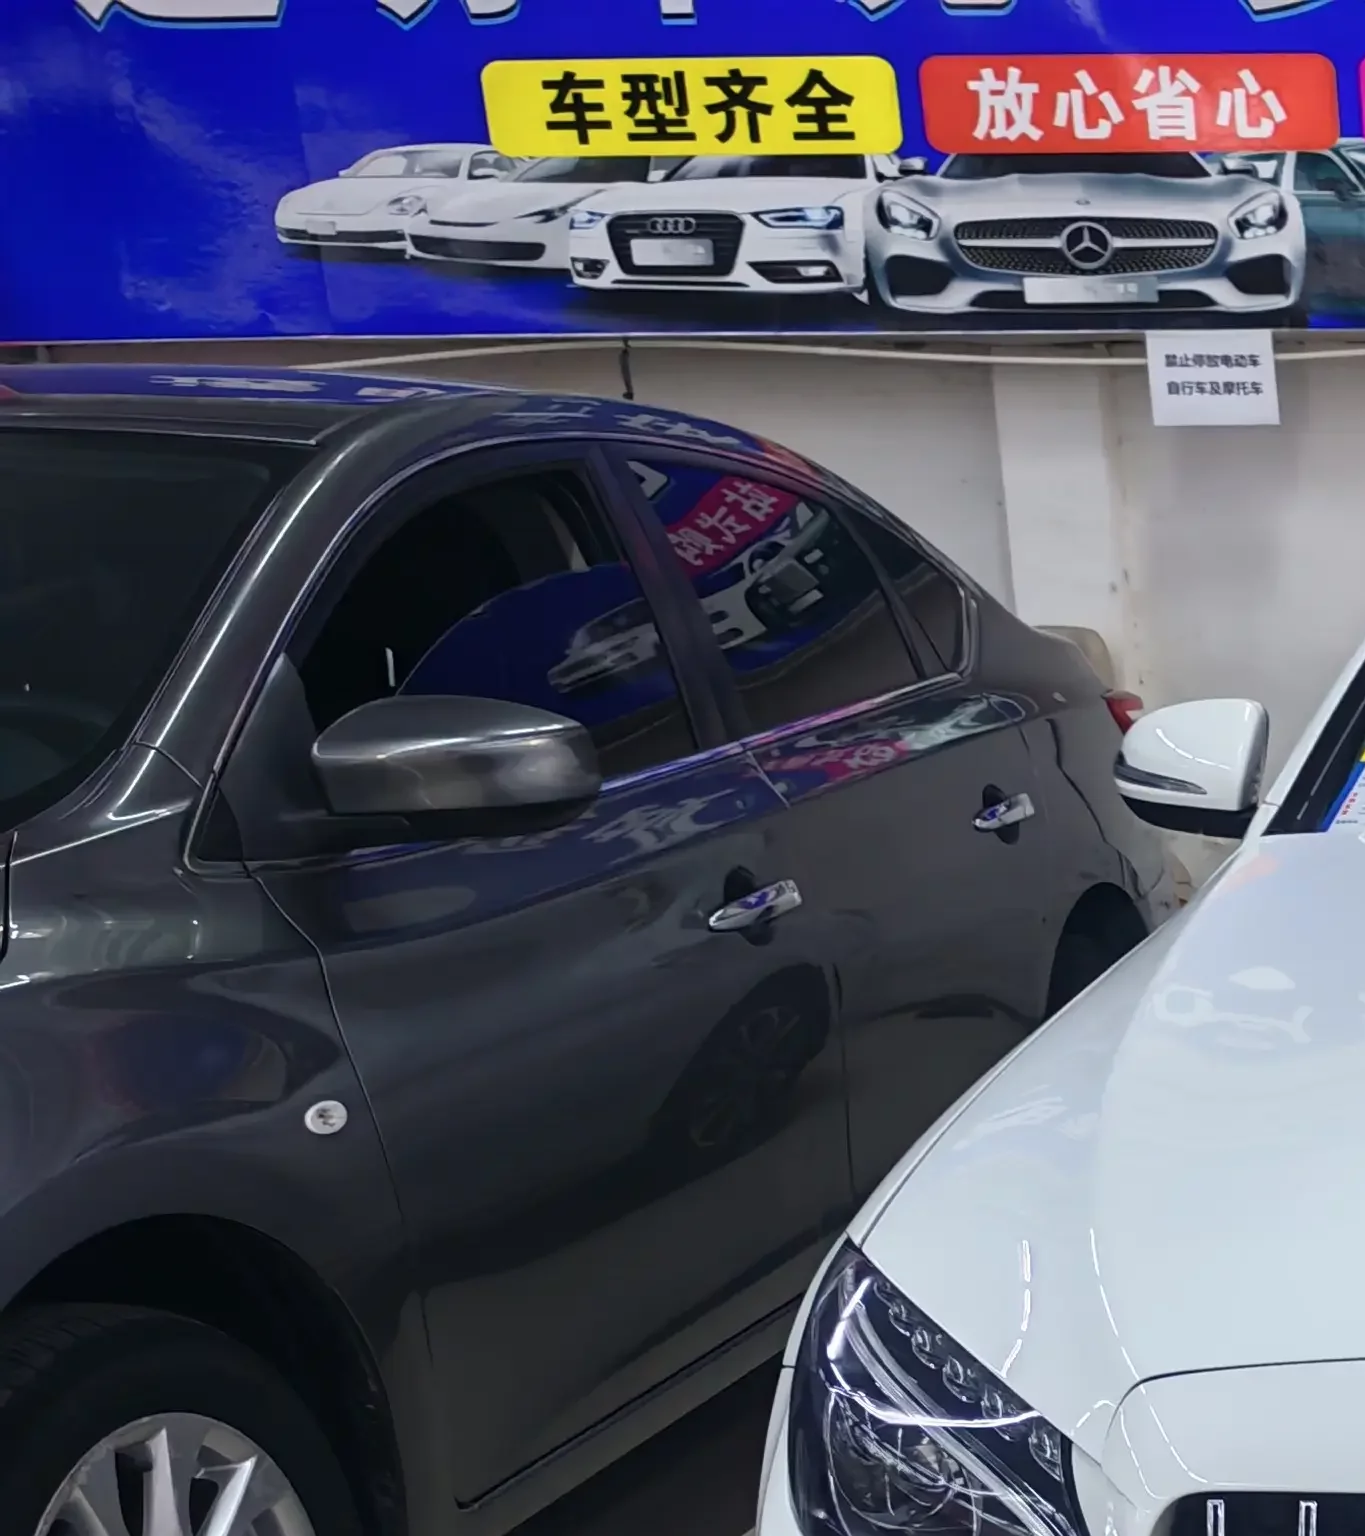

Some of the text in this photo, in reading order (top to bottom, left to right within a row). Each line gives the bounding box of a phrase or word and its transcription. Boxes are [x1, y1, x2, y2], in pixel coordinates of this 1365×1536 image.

[541, 68, 856, 145] 车型齐全
[967, 66, 1288, 142] 放心省心
[1164, 353, 1262, 368] 禁止停放电动车
[1166, 380, 1264, 396] 自行车及摩托车
